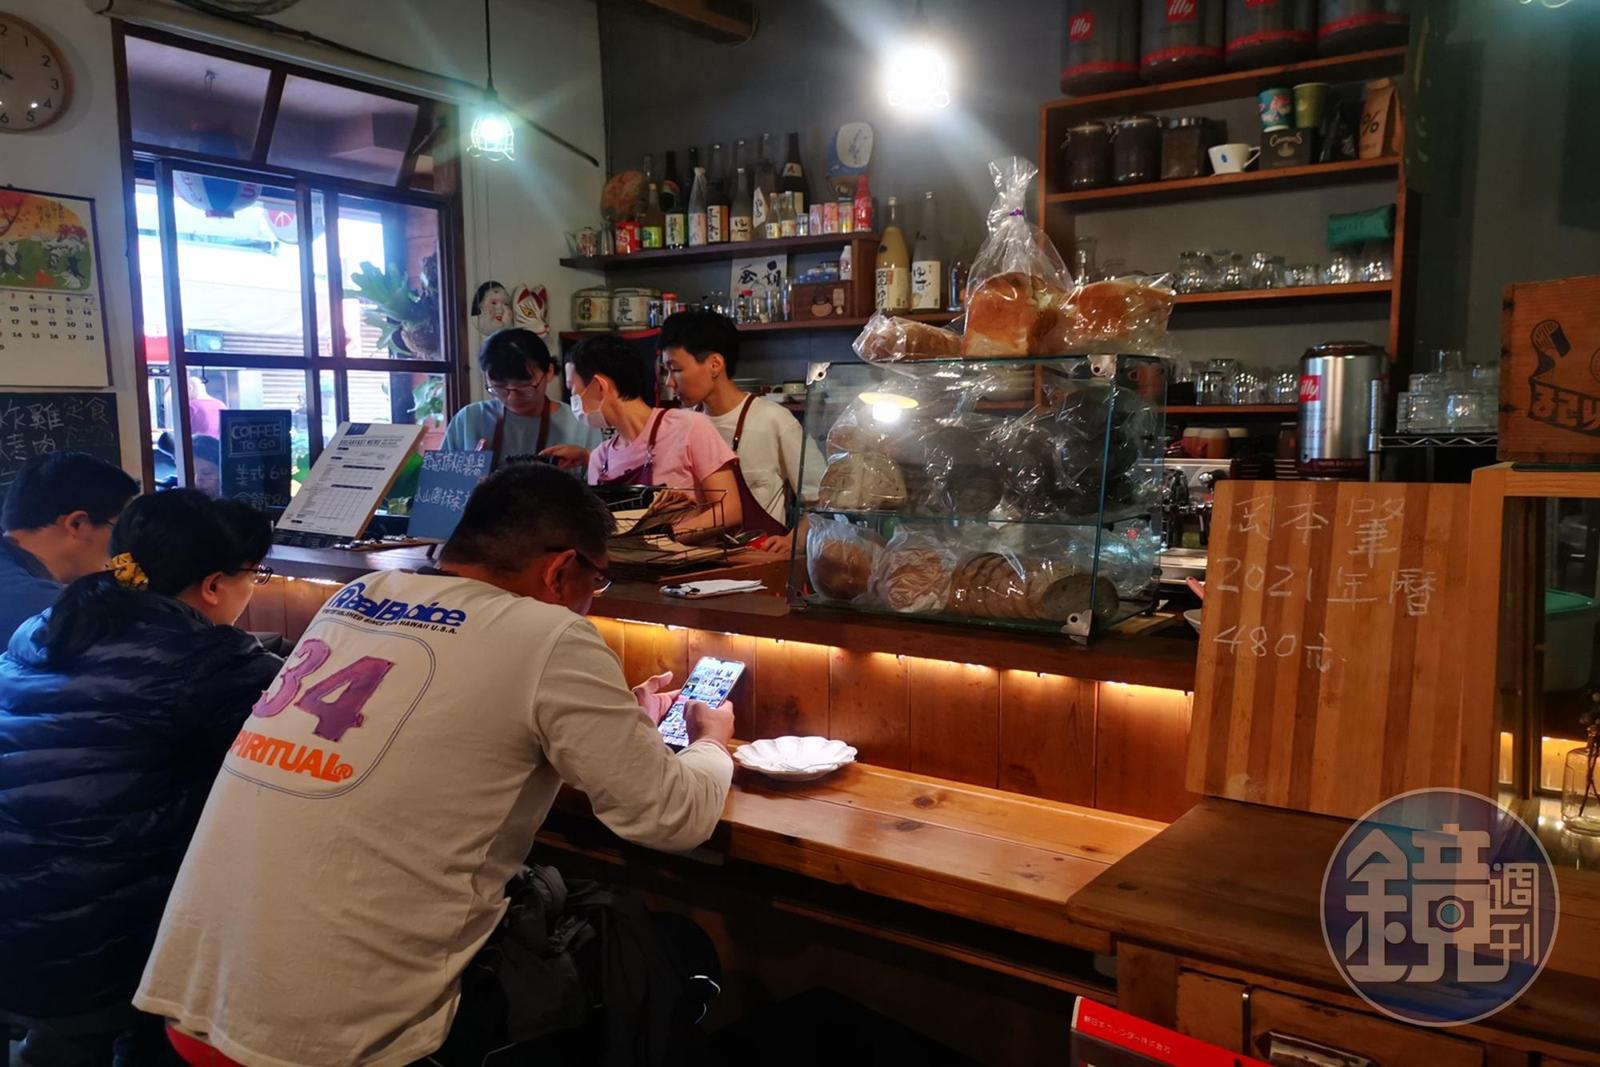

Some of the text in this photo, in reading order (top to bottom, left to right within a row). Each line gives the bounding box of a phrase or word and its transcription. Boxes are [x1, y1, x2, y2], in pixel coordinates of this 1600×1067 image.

[1070, 15, 1091, 36] illy
[41, 54, 51, 67] 2
[51, 79, 59, 90] 3
[43, 98, 52, 109] 4
[0, 112, 9, 124] 6
[26, 110, 34, 122] 5
[1300, 379, 1319, 399] illy
[231, 423, 280, 440] COFFEE
[241, 439, 276, 450] TO GO
[252, 638, 395, 743] 34
